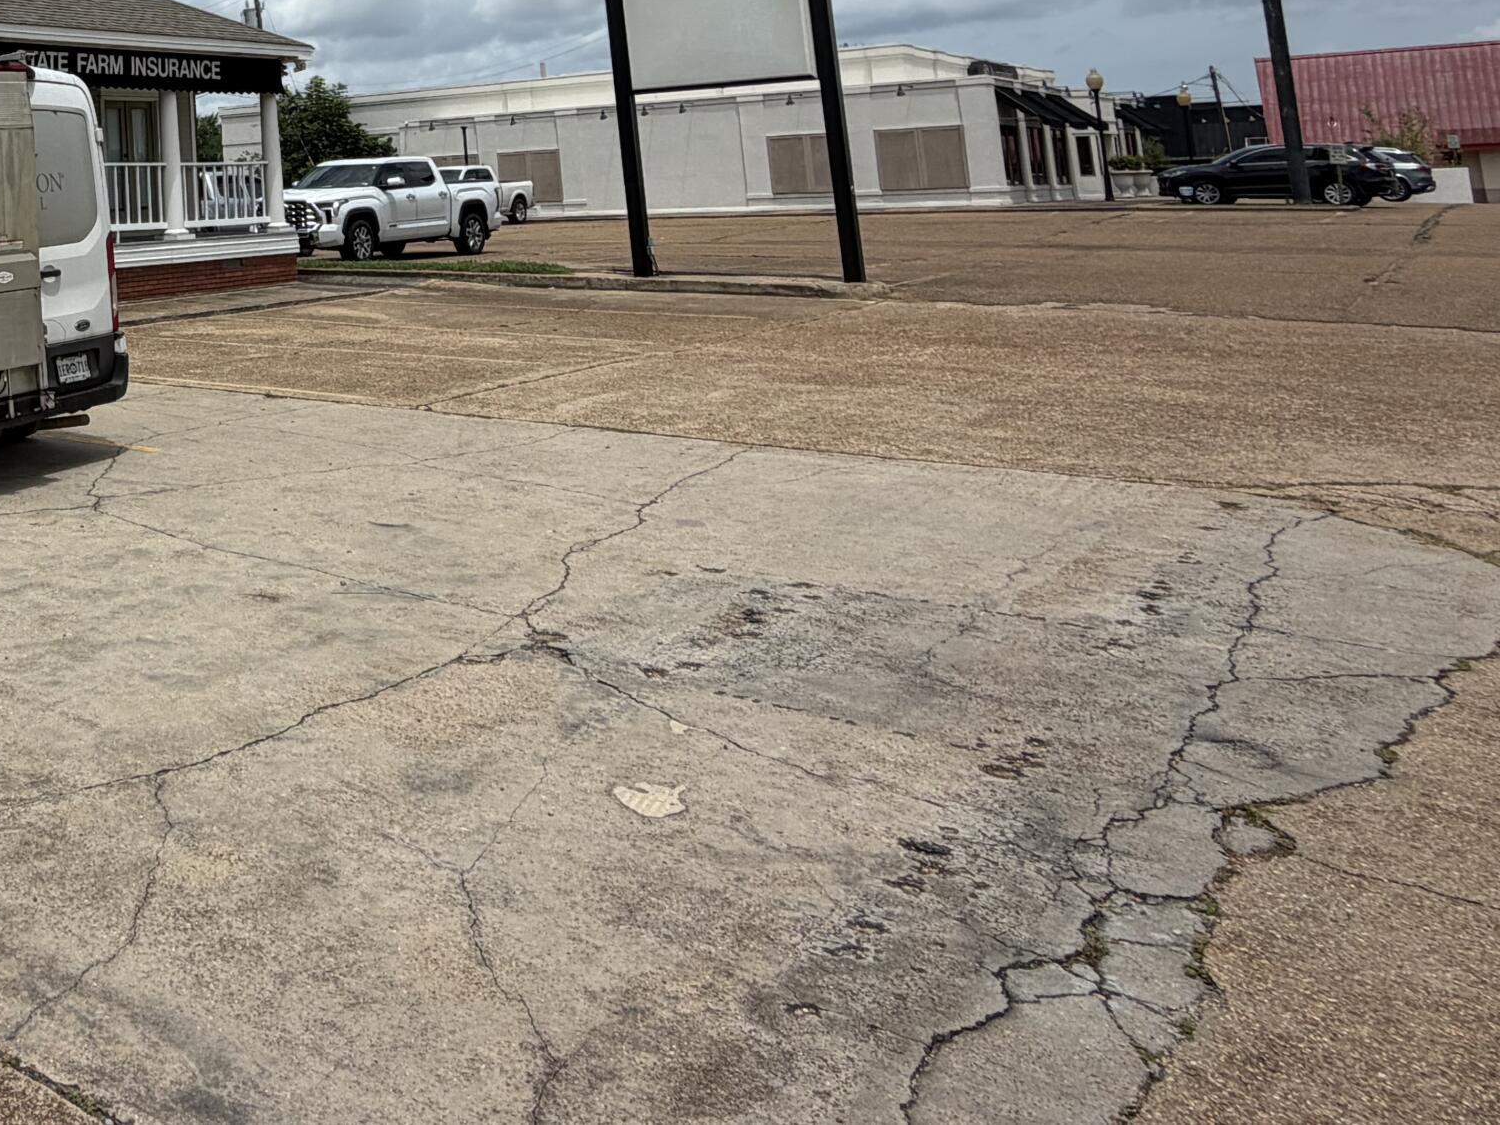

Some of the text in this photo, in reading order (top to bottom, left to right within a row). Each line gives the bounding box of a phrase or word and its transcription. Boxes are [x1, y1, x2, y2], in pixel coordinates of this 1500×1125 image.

[24, 50, 222, 80] TATE FARM INSURANCE
